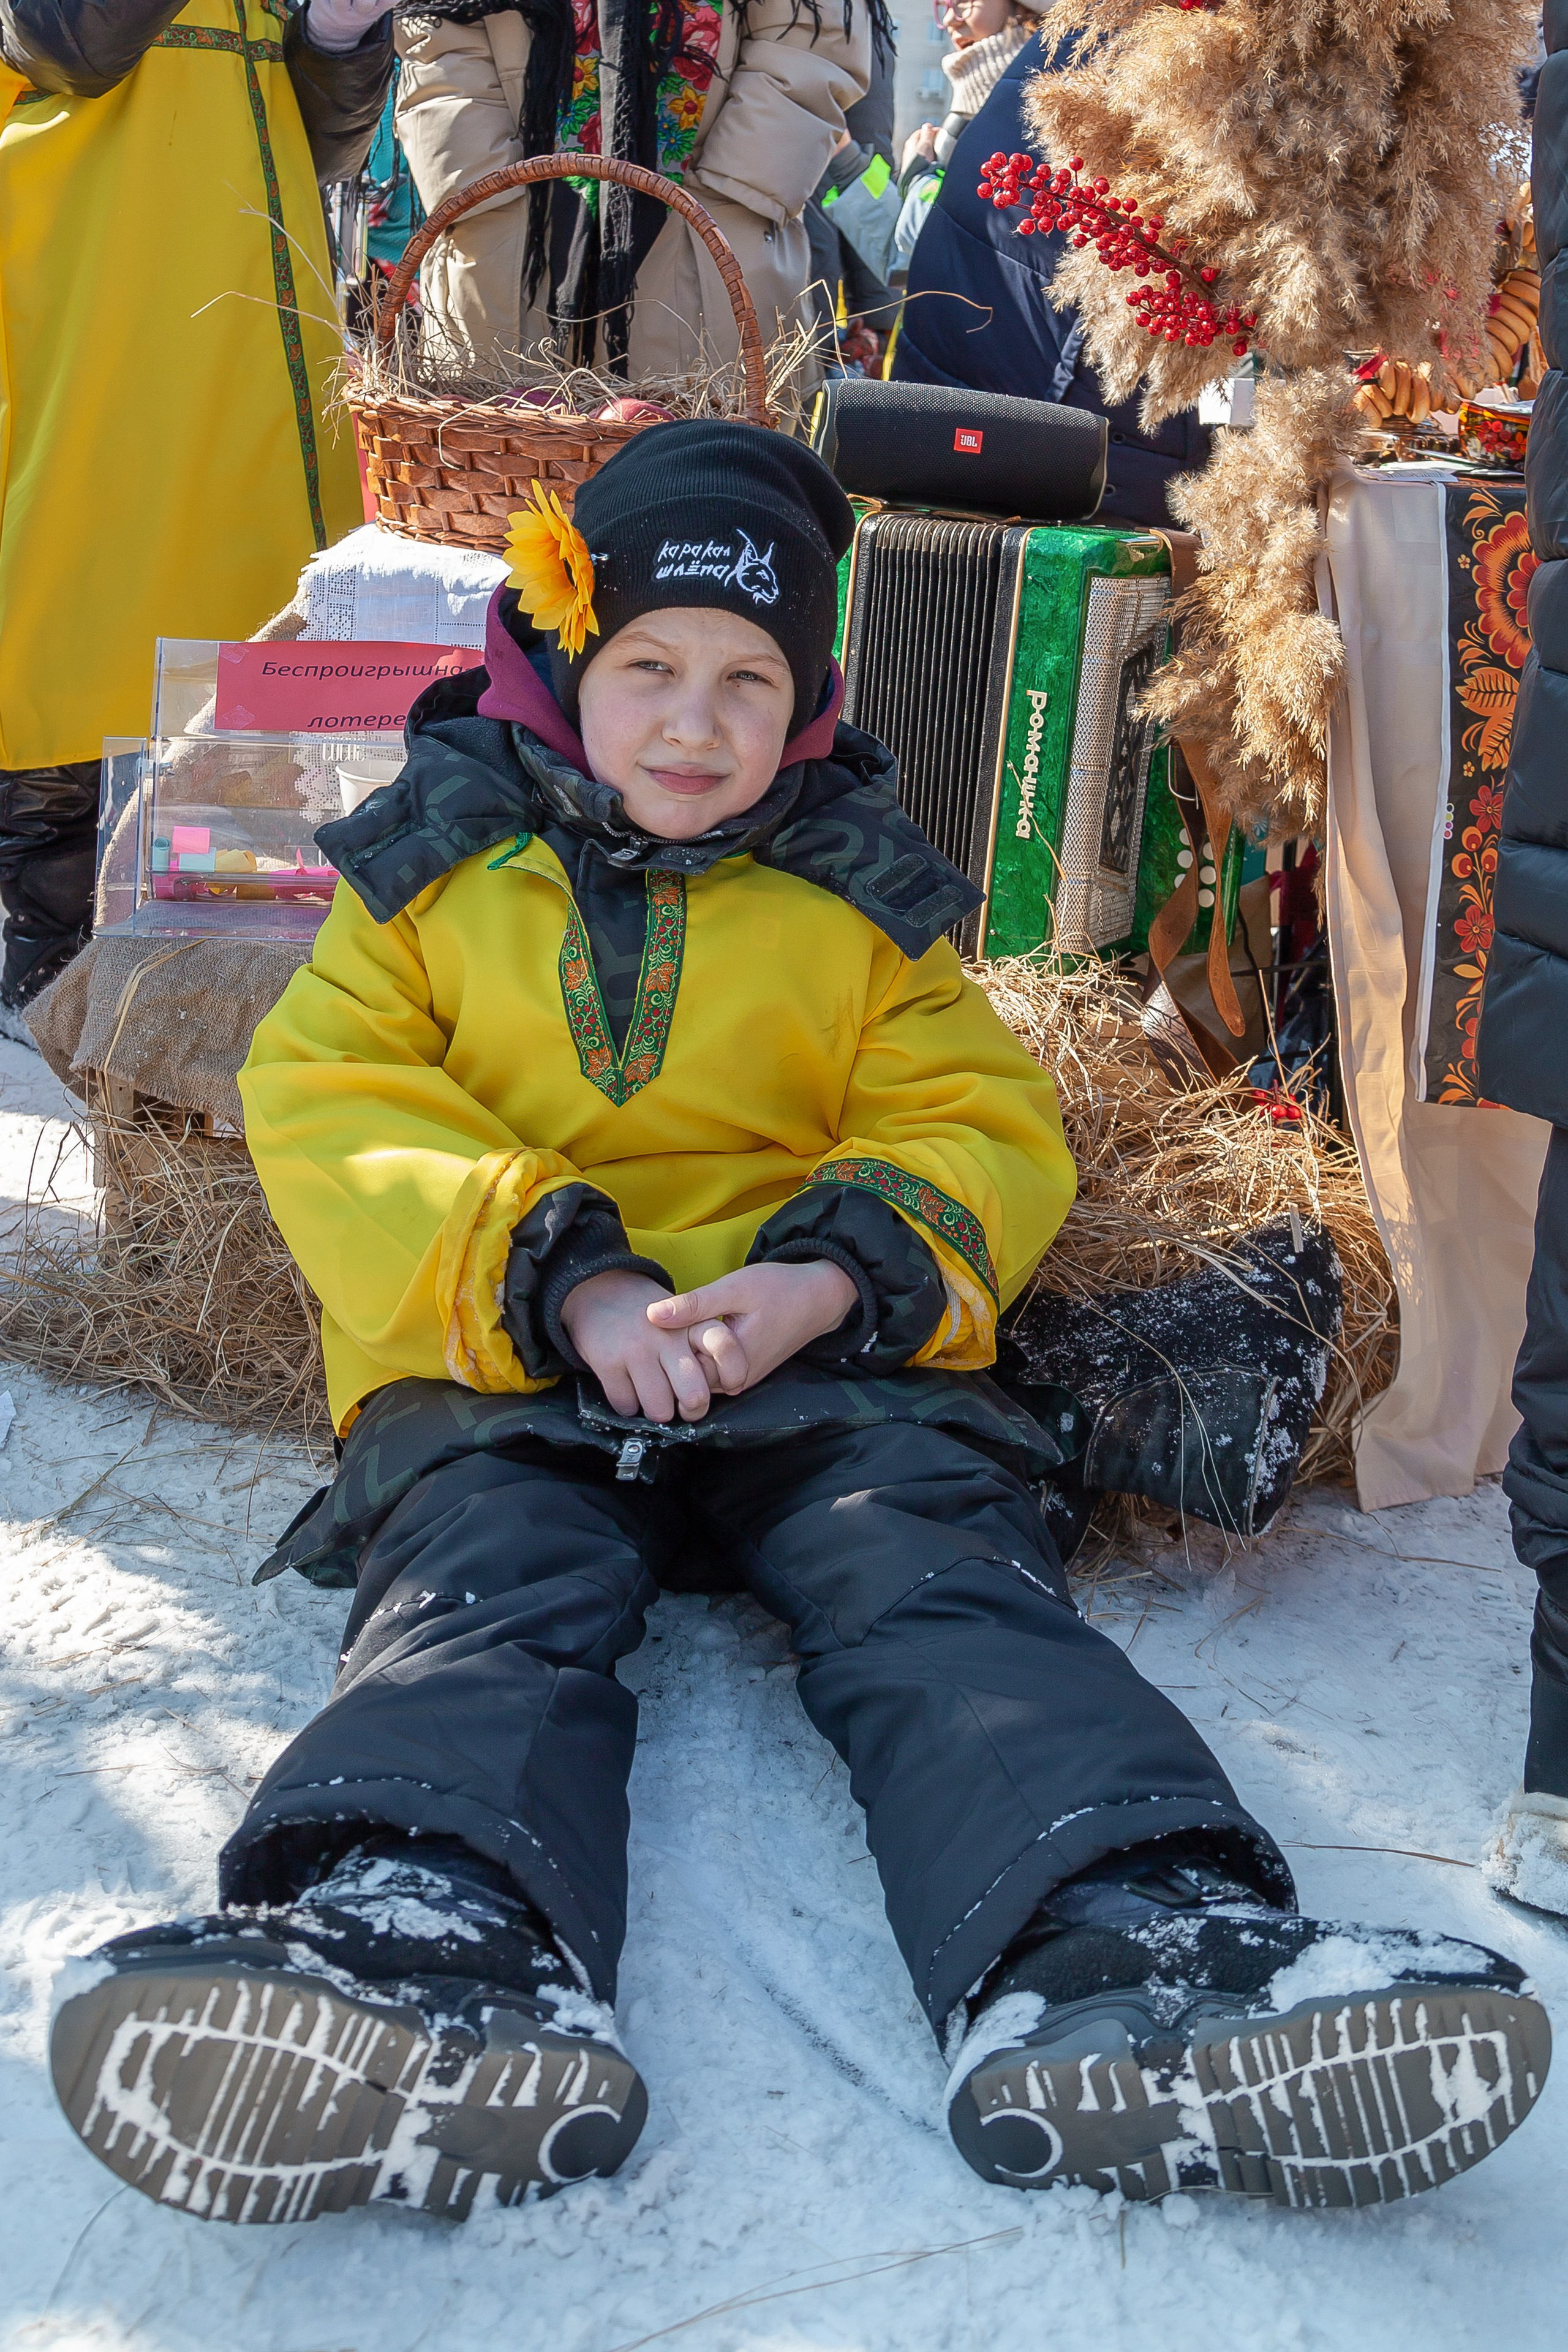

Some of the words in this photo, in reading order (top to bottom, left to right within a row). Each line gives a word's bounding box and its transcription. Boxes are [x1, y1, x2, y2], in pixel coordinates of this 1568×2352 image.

[960, 434, 978, 447] JBL
[657, 540, 731, 562] каракал
[262, 662, 471, 680] Беспроигрышна
[307, 714, 407, 729] лотере
[1015, 689, 1048, 839] Ромашка
